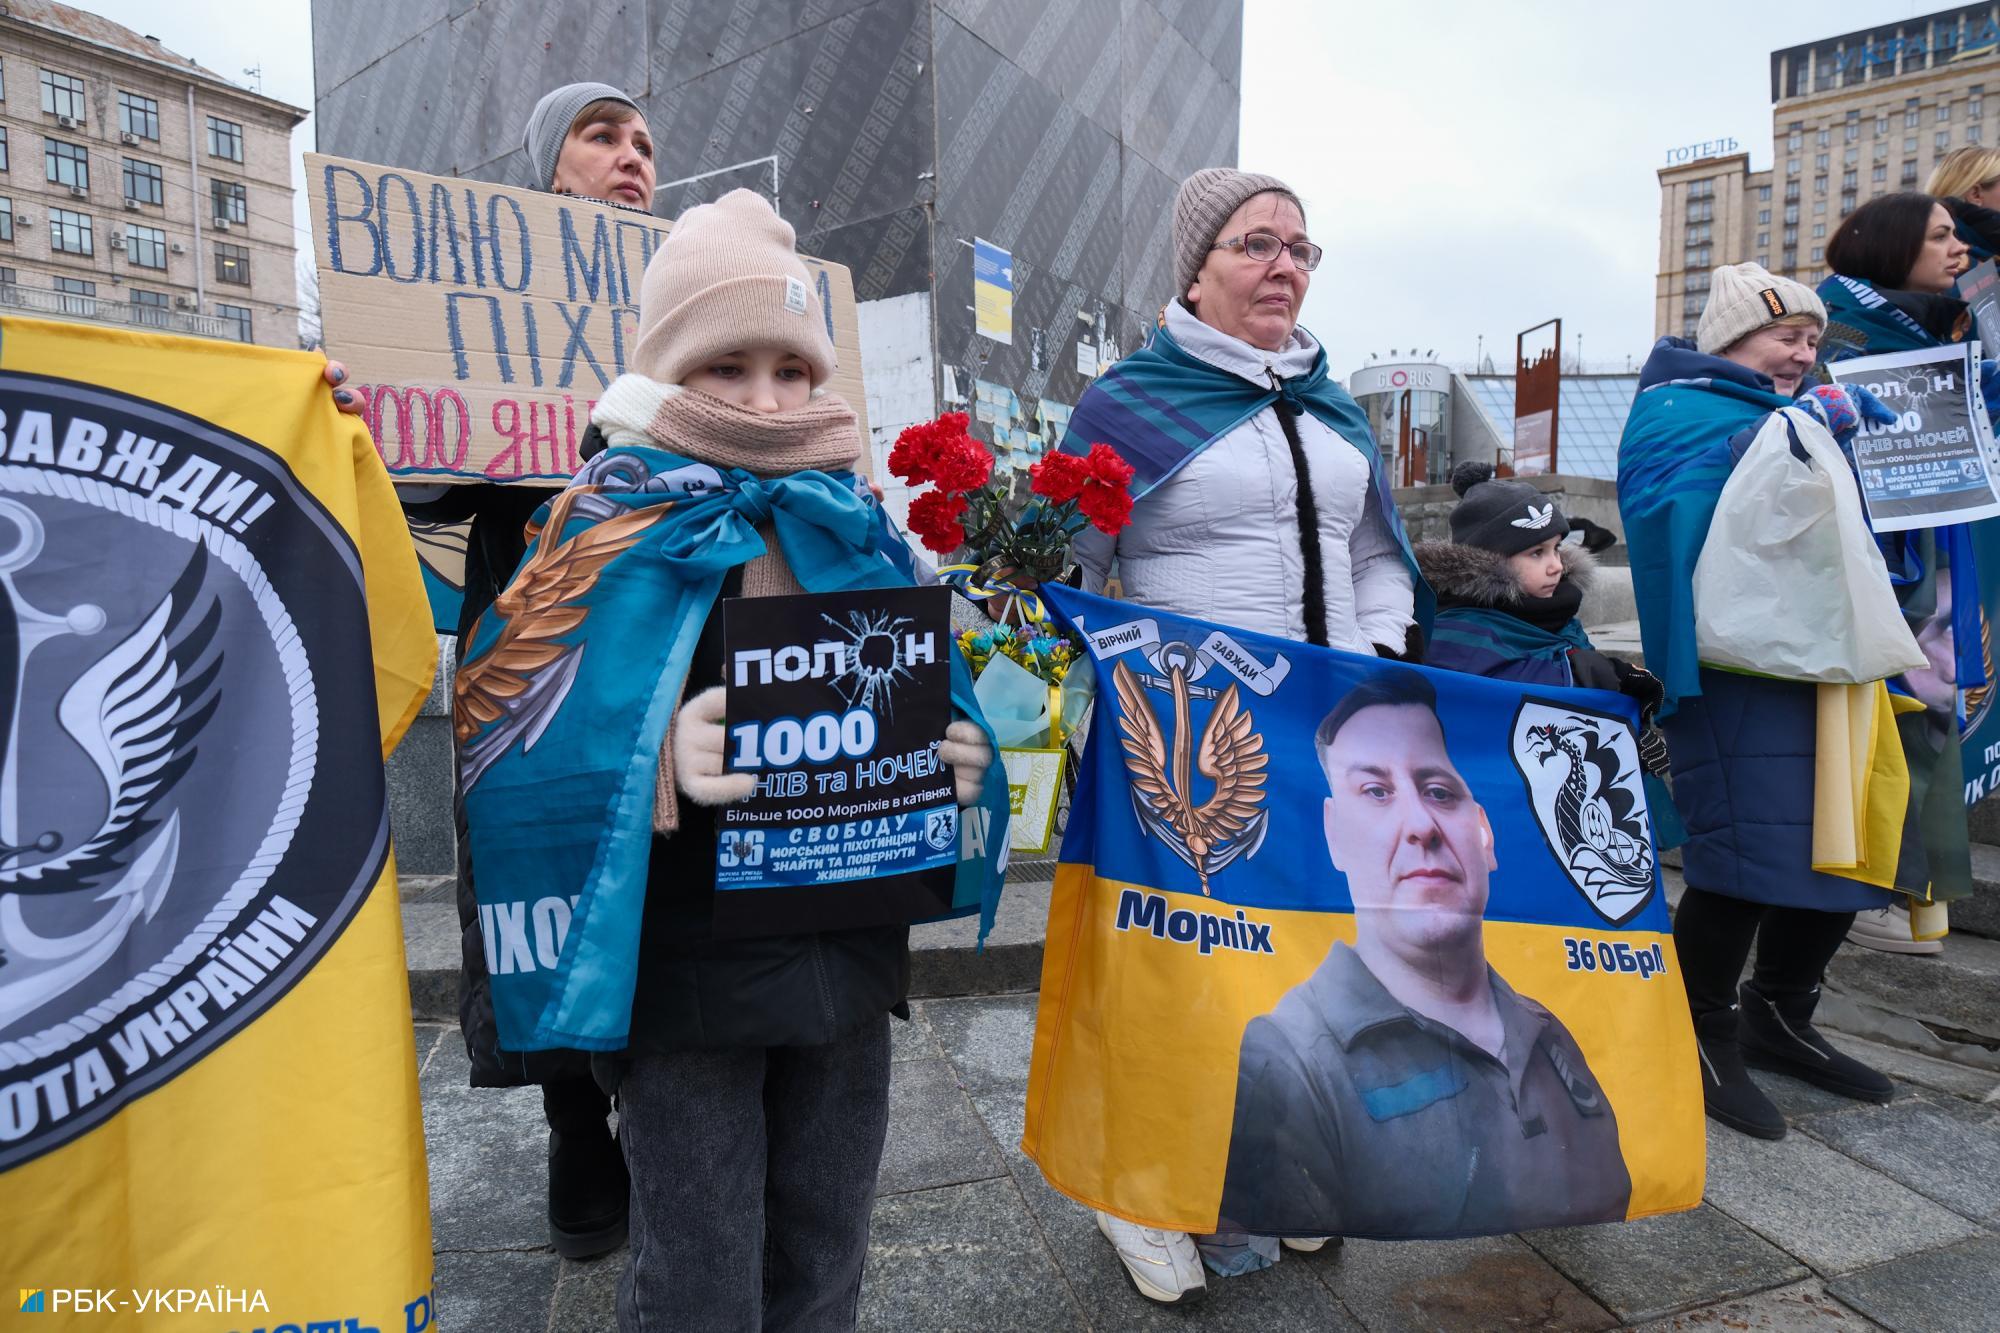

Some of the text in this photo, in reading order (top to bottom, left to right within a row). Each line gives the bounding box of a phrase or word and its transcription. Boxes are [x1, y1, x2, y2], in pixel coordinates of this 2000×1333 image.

[1666, 137, 1738, 163] ГОТЕЛЬ
[325, 164, 533, 293] ВОЛЮ
[1378, 370, 1432, 388] GLOBUS
[1858, 425, 1969, 456] ДНІВ та НОЧЕЙ
[0, 408, 276, 534] АВЖДИ!
[1097, 625, 1260, 681] ВІРНИЙ ЗАВЖДИ
[732, 709, 876, 769] 1000
[742, 740, 946, 803] НІВ та НОЧЕЙ
[726, 786, 952, 822] Більше 1000 Морпіхів в катівнях
[719, 830, 765, 867] 36
[769, 843, 840, 859] МОРСЬКИМ
[772, 857, 825, 873] ЗНАЙТИ
[827, 857, 844, 868] ТА
[846, 846, 917, 866] ПОВЕРНУТИ
[815, 865, 877, 881] ЖИВИМИ!
[1115, 888, 1275, 955] Морпіх
[108, 894, 320, 1075] УКРАЇНИ
